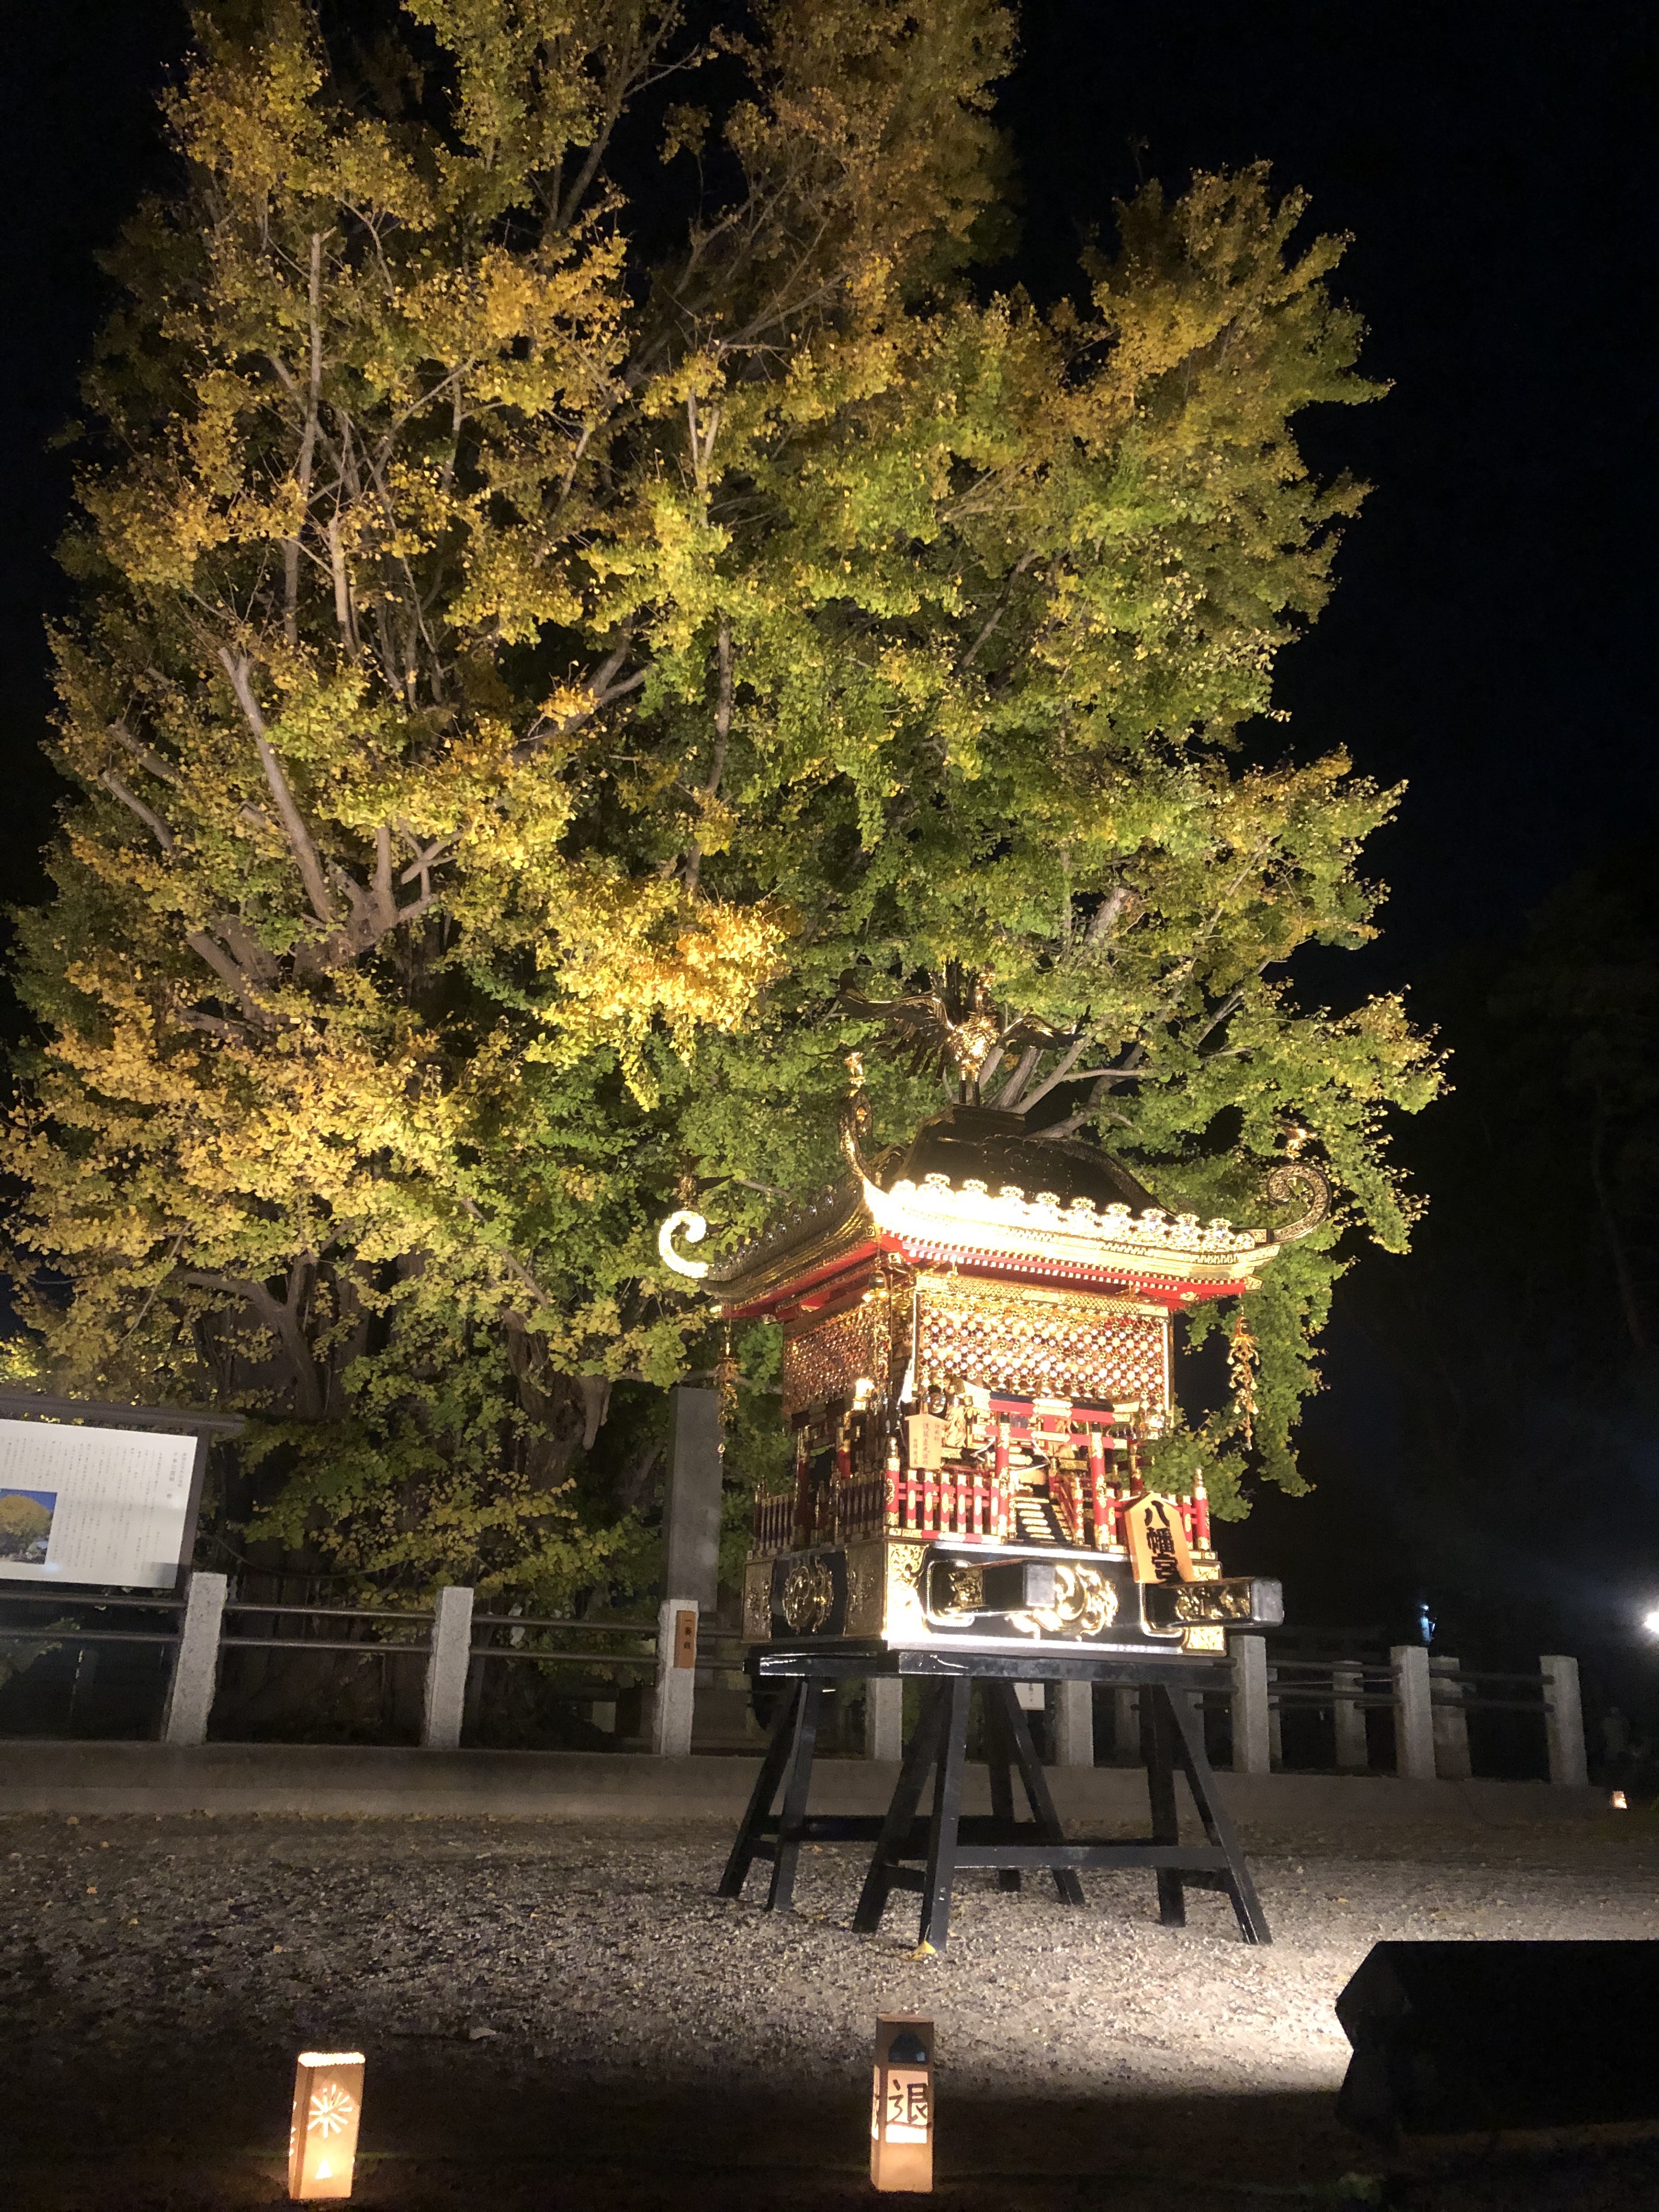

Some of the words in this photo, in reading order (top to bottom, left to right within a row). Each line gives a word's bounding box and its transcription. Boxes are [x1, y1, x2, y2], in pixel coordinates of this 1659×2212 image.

[1144, 1500, 1182, 1585] 八幡宮
[887, 2079, 933, 2130] 退
